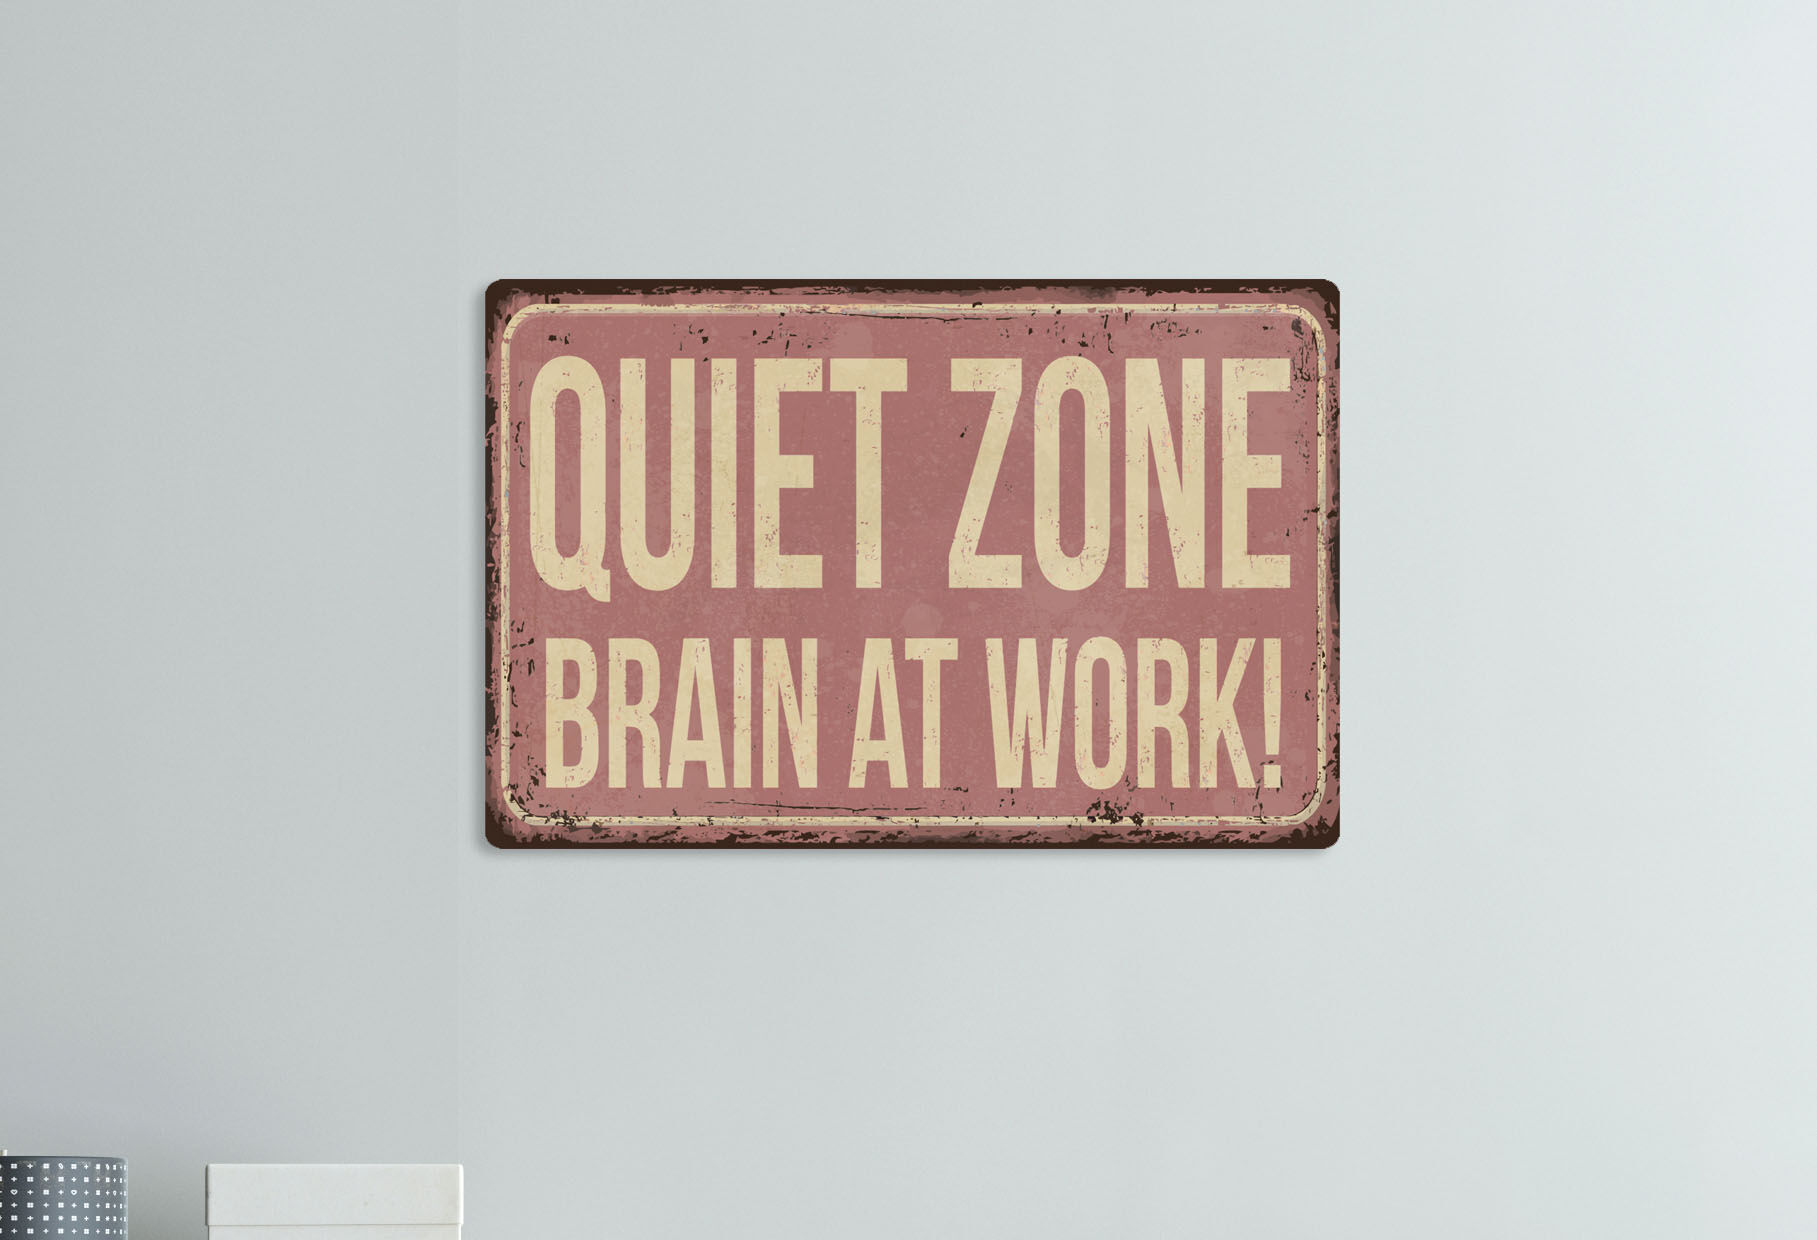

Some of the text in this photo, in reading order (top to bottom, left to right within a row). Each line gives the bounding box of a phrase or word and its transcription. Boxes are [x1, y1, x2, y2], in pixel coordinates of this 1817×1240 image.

[529, 355, 1291, 602] QUIET ZONE
[545, 637, 1282, 790] BRAIN AT WORK!
